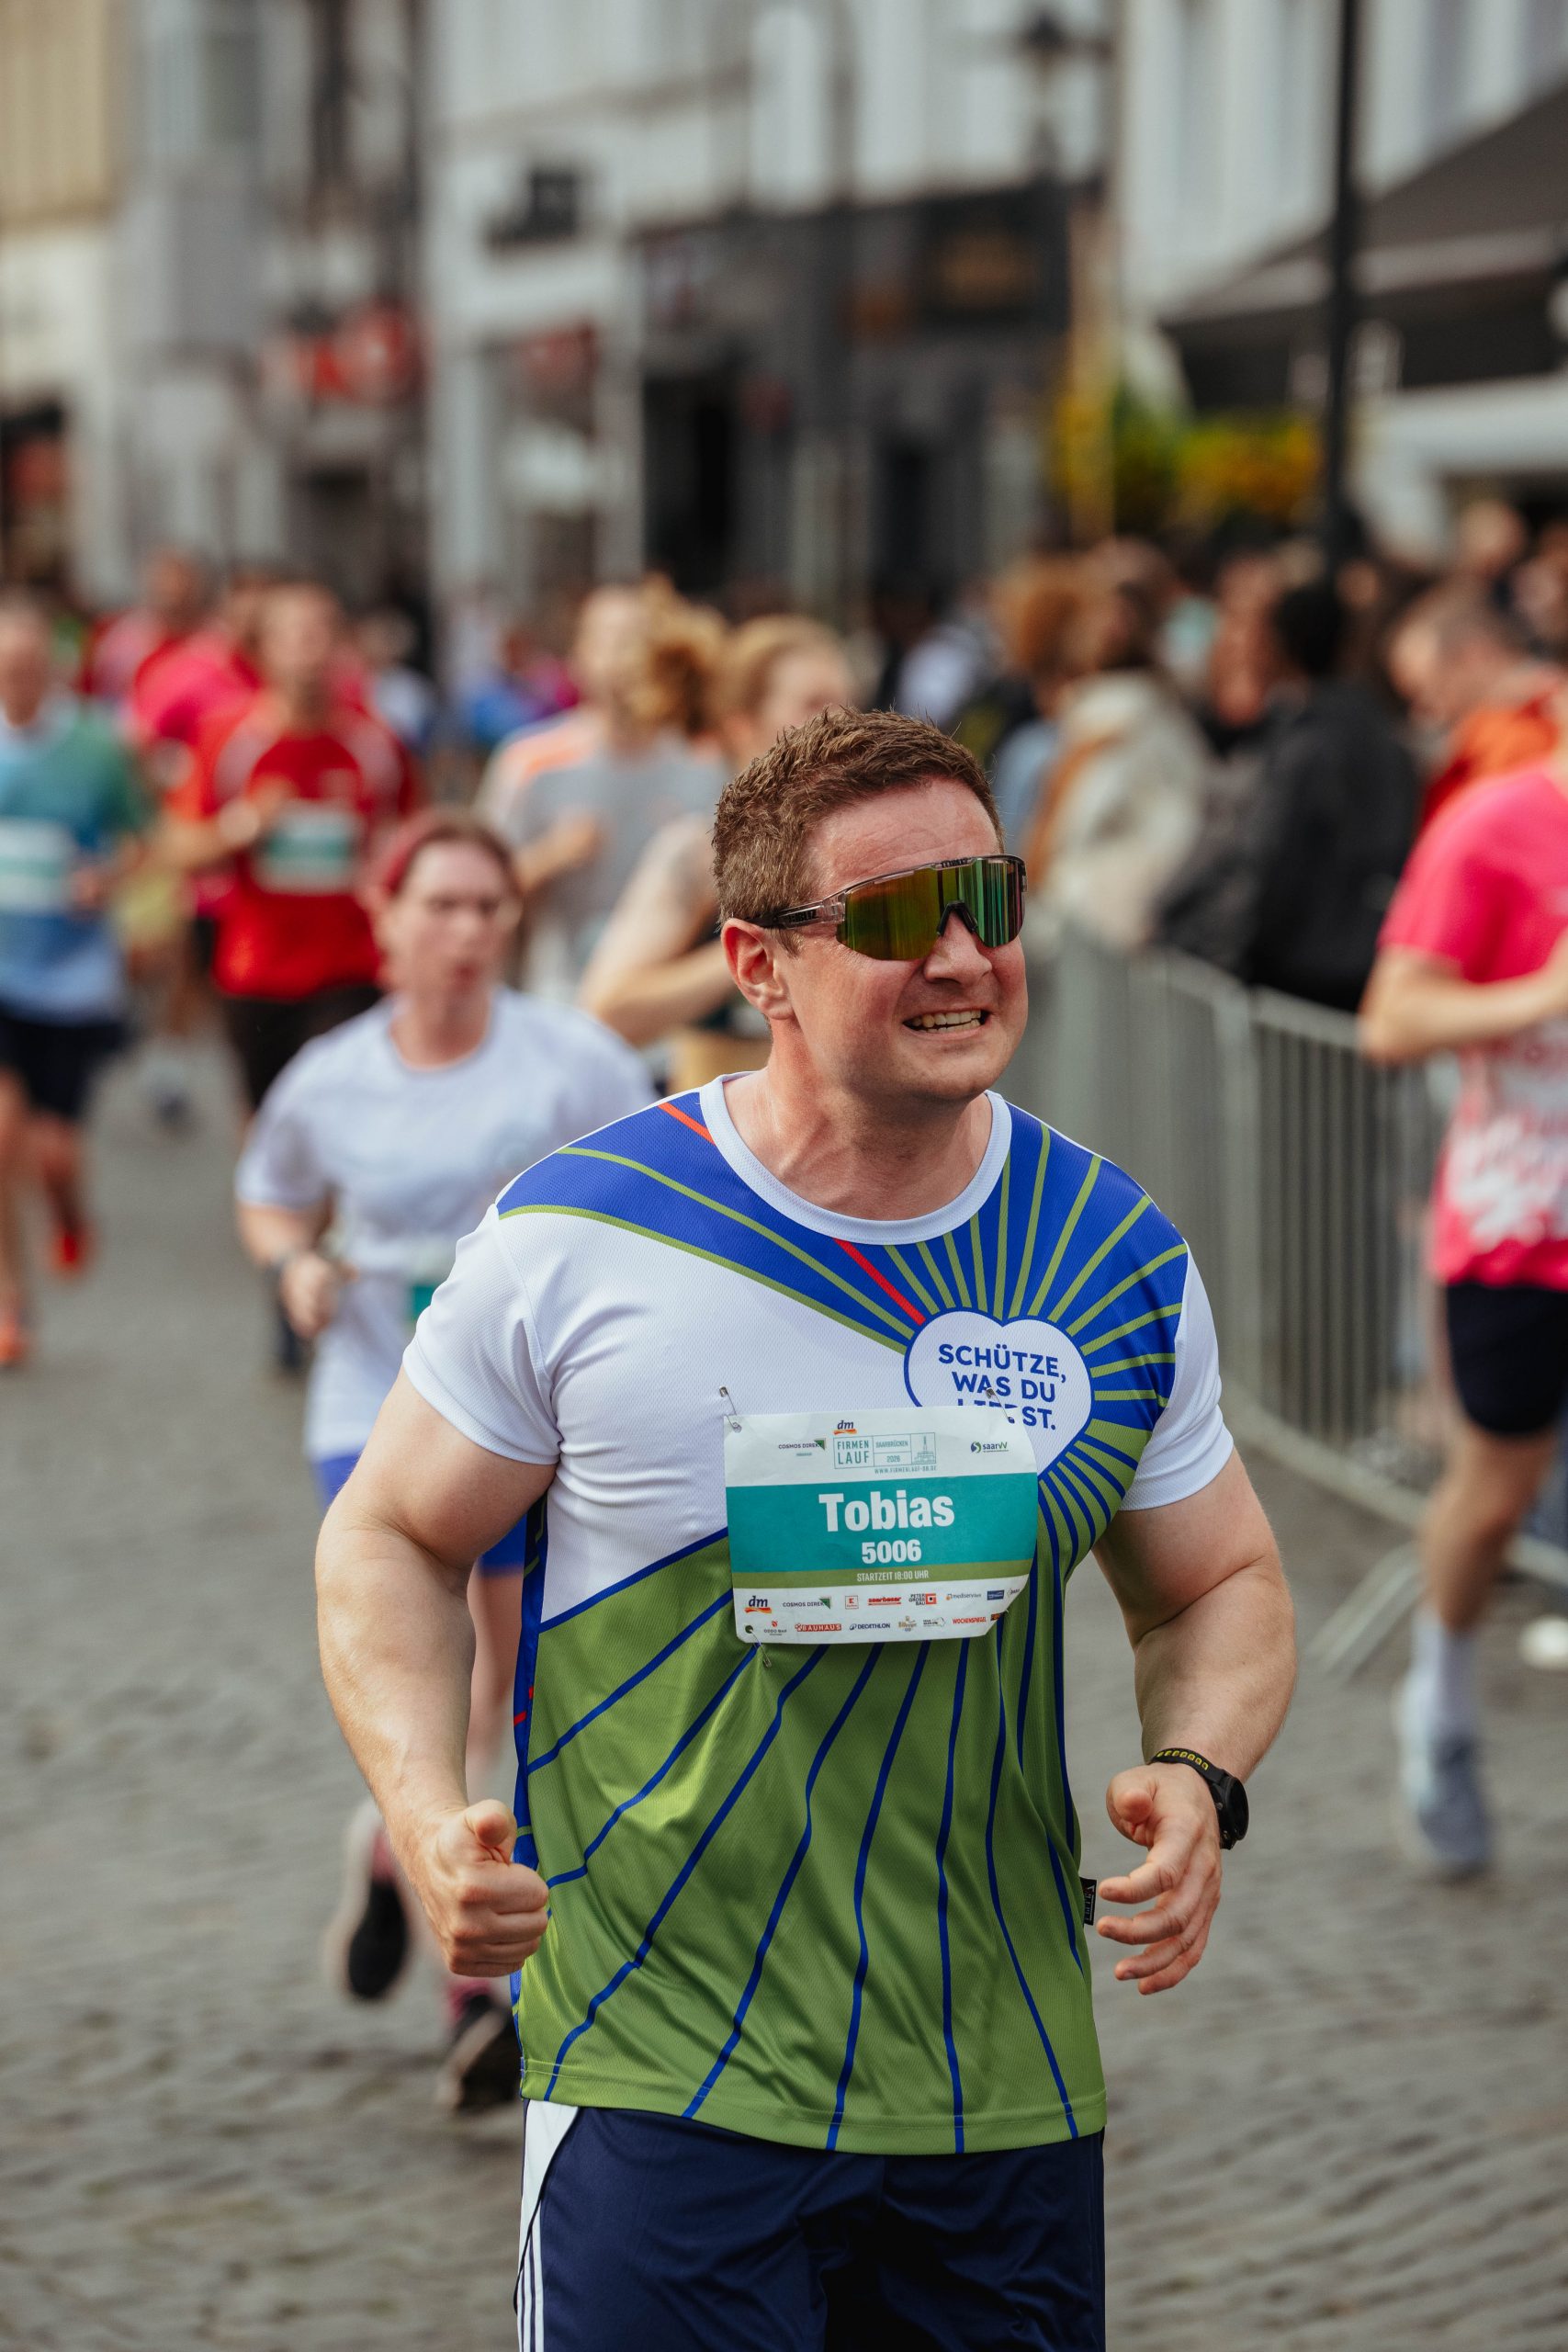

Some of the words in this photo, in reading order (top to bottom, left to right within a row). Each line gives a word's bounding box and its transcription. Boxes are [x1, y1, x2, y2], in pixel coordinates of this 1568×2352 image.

[938, 1343, 1066, 1384] SCHÜTZE,
[952, 1371, 1011, 1397] WAS
[1021, 1378, 1055, 1403] DU
[837, 1419, 854, 1430] dm
[837, 1440, 869, 1451] FIRMEN
[838, 1451, 870, 1465] LAUF
[818, 1489, 954, 1532] Tobias
[862, 1539, 922, 1565] 5006
[857, 1572, 894, 1582] STARTZEIT
[895, 1571, 913, 1580] 18:00
[915, 1570, 930, 1579] UHR
[748, 1595, 769, 1608] dm
